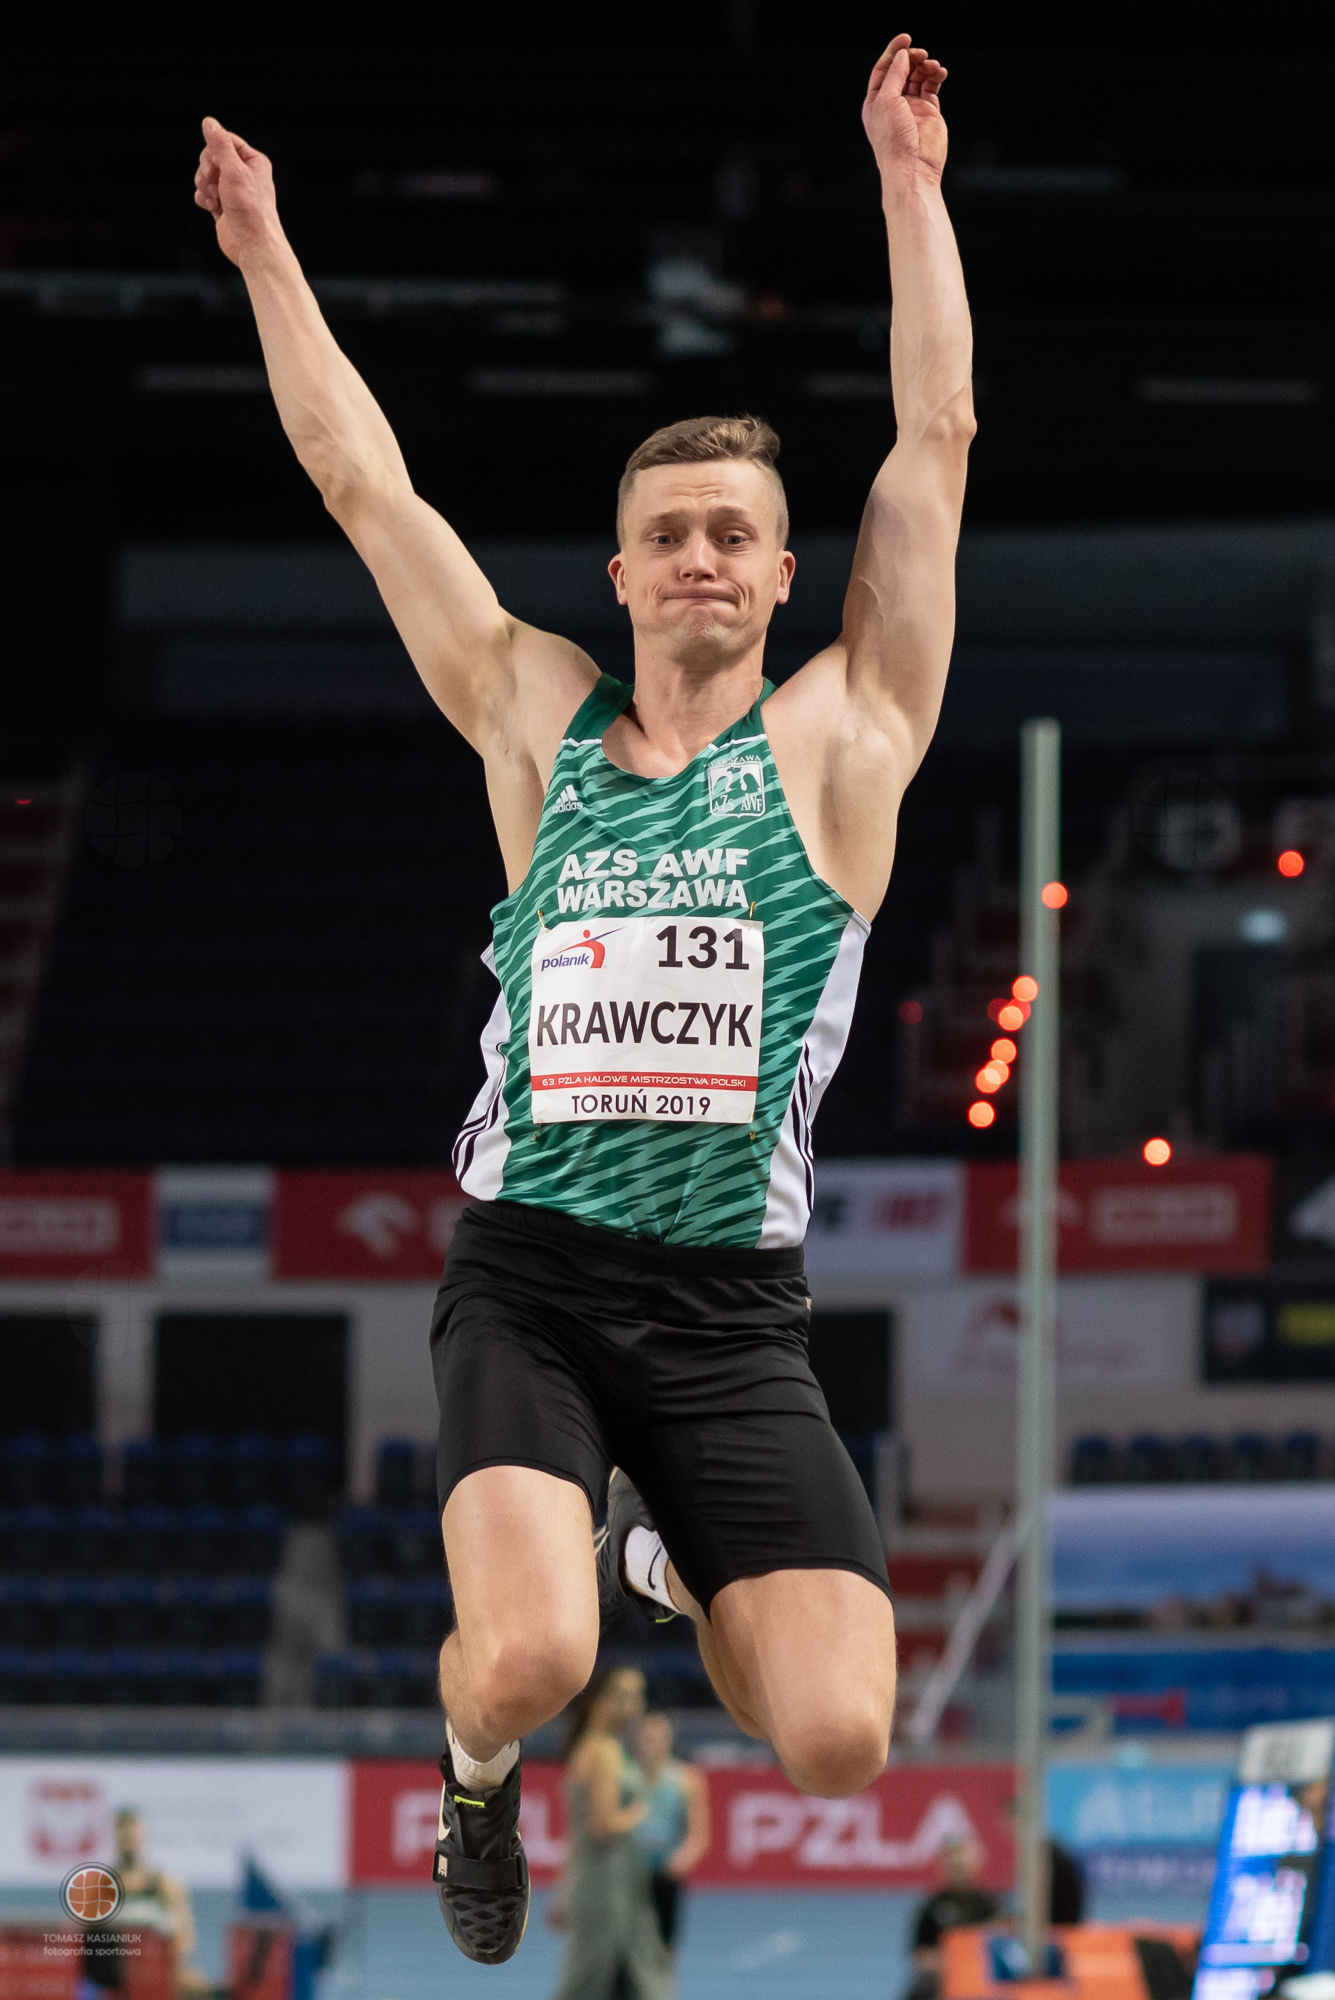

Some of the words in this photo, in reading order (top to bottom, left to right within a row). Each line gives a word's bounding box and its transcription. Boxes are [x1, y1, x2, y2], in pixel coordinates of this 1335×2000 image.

[552, 799, 583, 814] adidas
[713, 795, 735, 812] AZS
[742, 793, 763, 812] AWF
[557, 848, 638, 883] AZS
[651, 848, 749, 878] AWF
[556, 878, 749, 914] WARSZAWA
[541, 952, 590, 971] polanik
[656, 925, 749, 970] 131
[536, 1000, 753, 1048] KRAWCZYK
[542, 1078, 556, 1086] 63.
[558, 1076, 582, 1086] PZLA
[584, 1075, 628, 1084] HALOWE
[630, 1075, 709, 1086] MISTRZOSTWA
[711, 1077, 746, 1087] POLSKI
[571, 1089, 647, 1115] TORUŃ
[655, 1095, 711, 1116] 2019
[727, 1789, 985, 1869] PZLA
